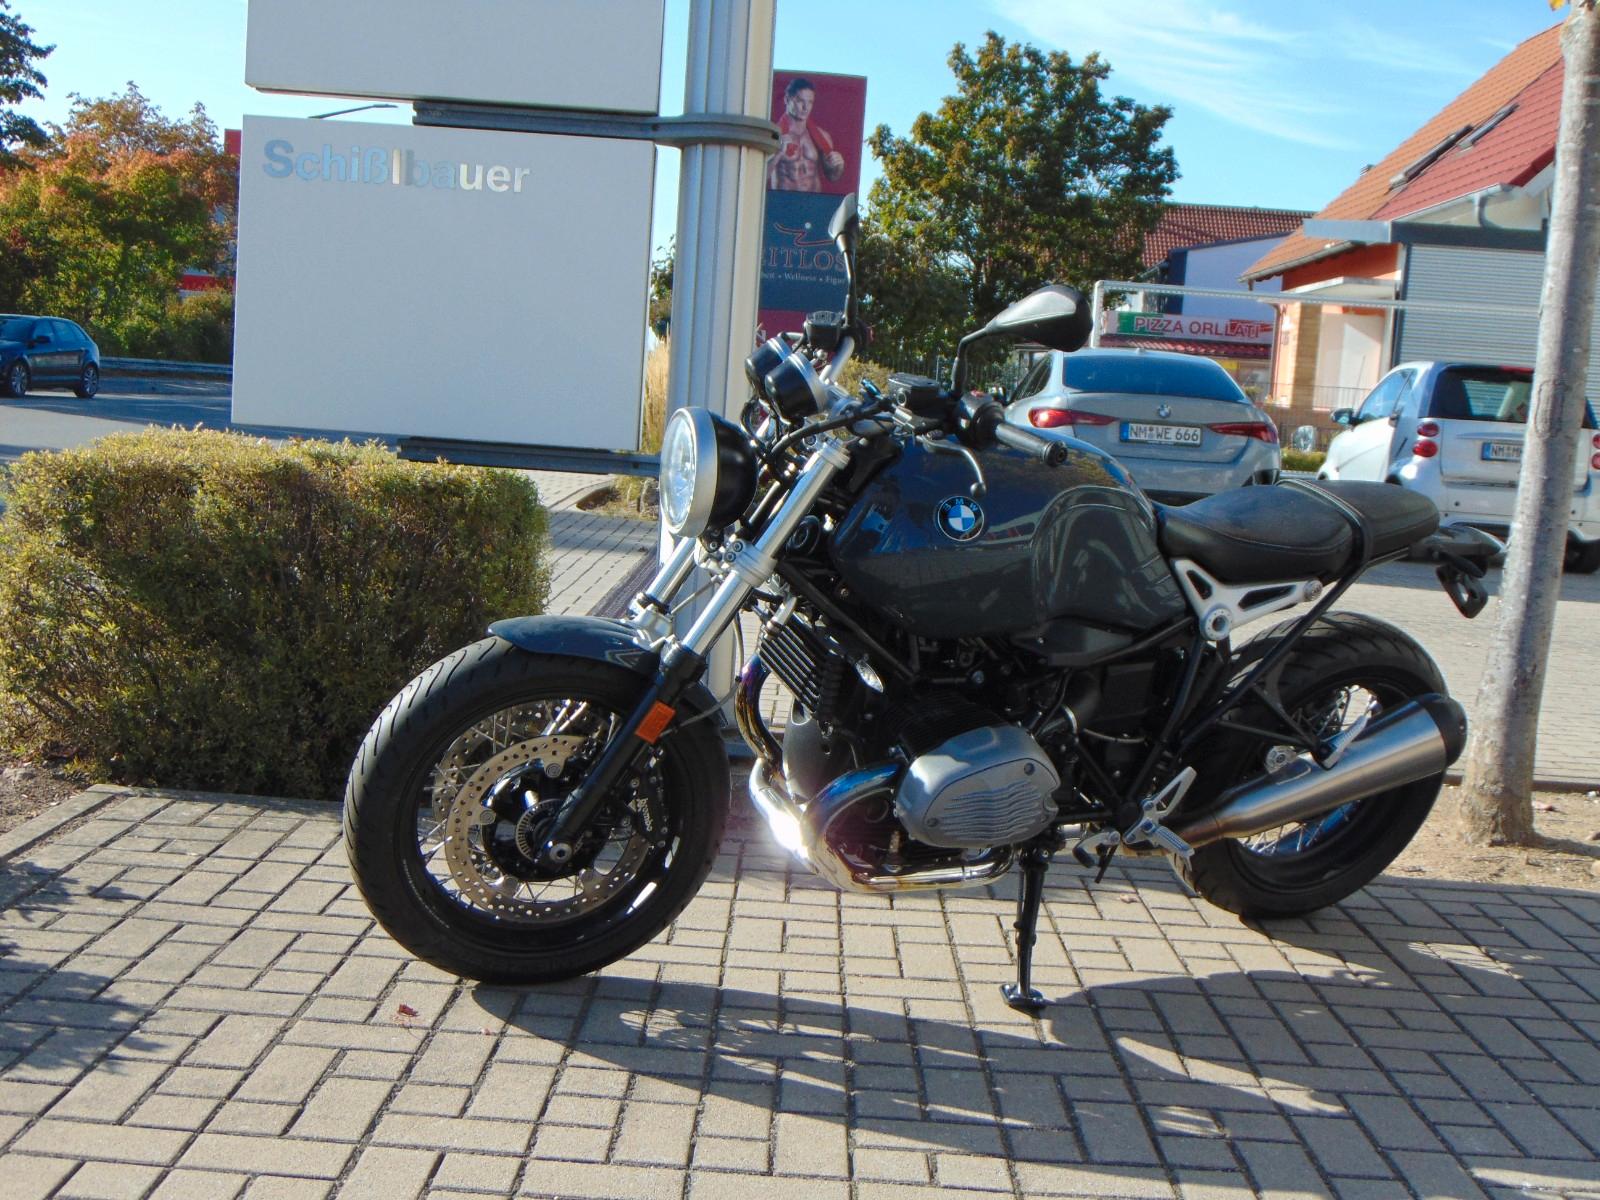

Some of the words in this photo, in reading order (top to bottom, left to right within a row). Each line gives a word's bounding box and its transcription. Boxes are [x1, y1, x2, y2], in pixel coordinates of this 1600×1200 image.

[263, 139, 531, 193] Schißlbauer
[762, 247, 846, 272] ITLOS
[1134, 316, 1184, 334] PIZZA
[1175, 428, 1199, 442] 666
